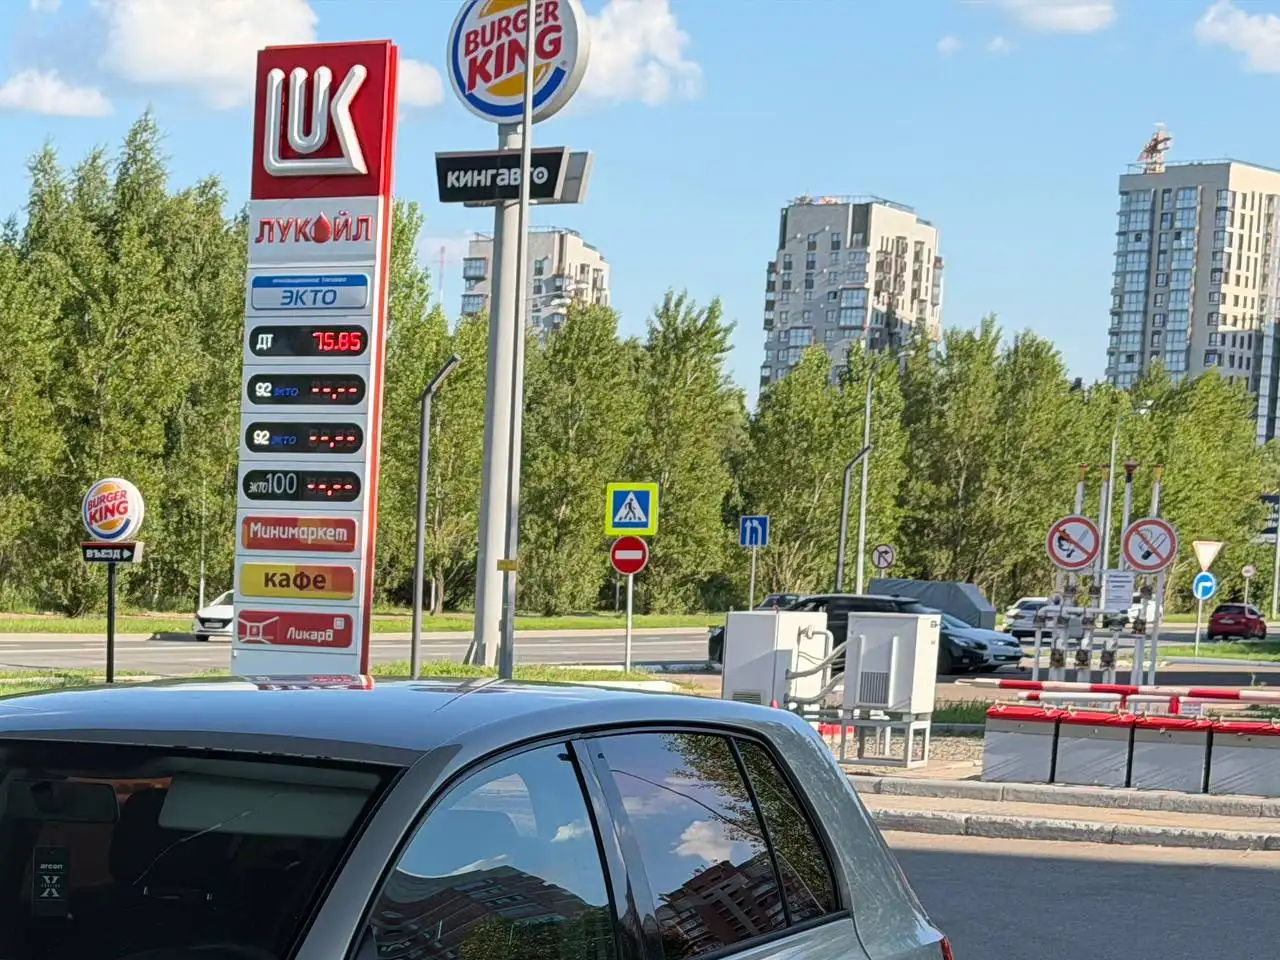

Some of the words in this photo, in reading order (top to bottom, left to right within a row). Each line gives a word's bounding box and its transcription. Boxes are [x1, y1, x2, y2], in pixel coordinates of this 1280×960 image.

[465, 1, 558, 57] BURGER
[467, 25, 562, 92] KING
[447, 166, 549, 188] кингаво
[280, 289, 337, 306] ЭКТО
[256, 333, 274, 350] ДТ
[312, 332, 361, 351] 75.85
[255, 382, 272, 397] 92
[253, 430, 270, 445] 92
[88, 490, 127, 511] BURGER
[89, 501, 128, 525] KING
[249, 523, 347, 544] Минимаркет
[264, 571, 327, 591] кафе
[287, 627, 333, 643] Ликард
